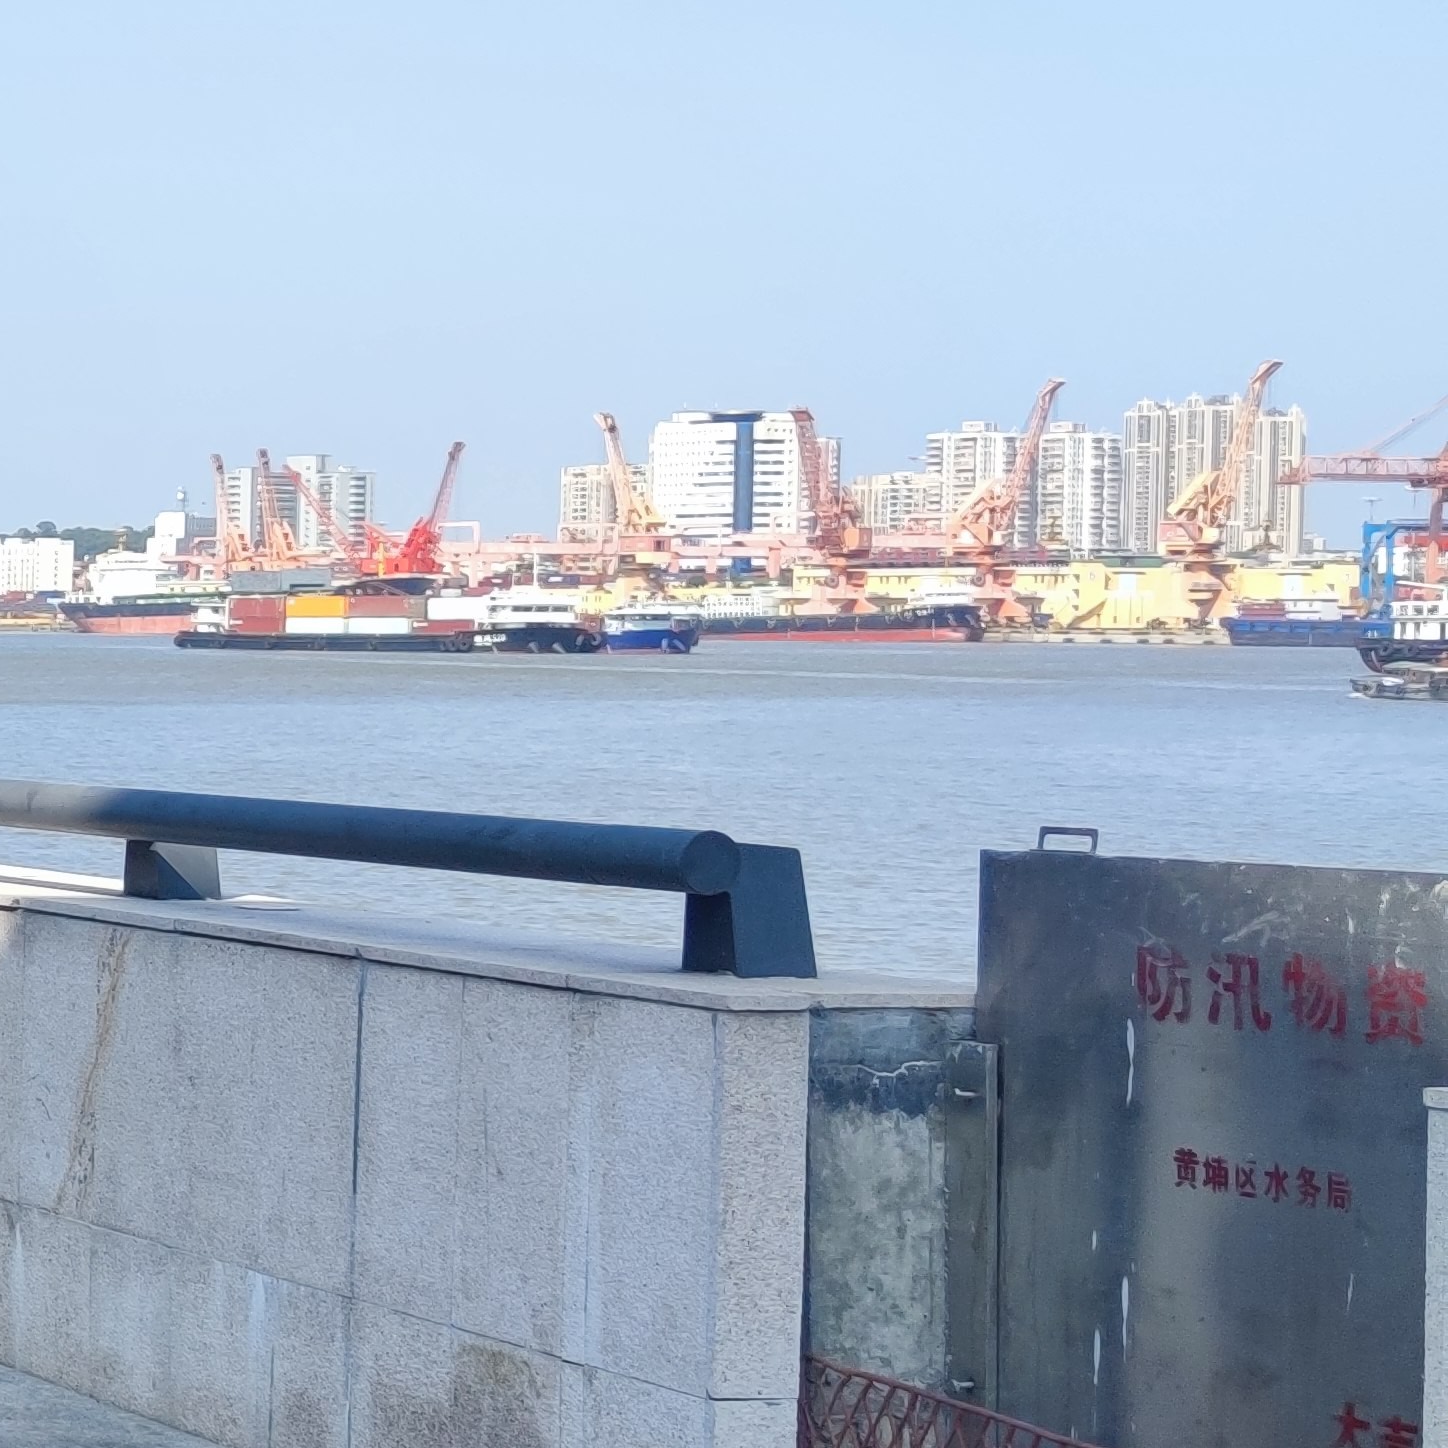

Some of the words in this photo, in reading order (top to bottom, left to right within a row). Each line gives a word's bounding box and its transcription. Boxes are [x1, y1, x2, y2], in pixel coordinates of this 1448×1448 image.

[1137, 946, 1430, 1047] 防汛物资
[1173, 1147, 1353, 1213] 黄埔区水务局
